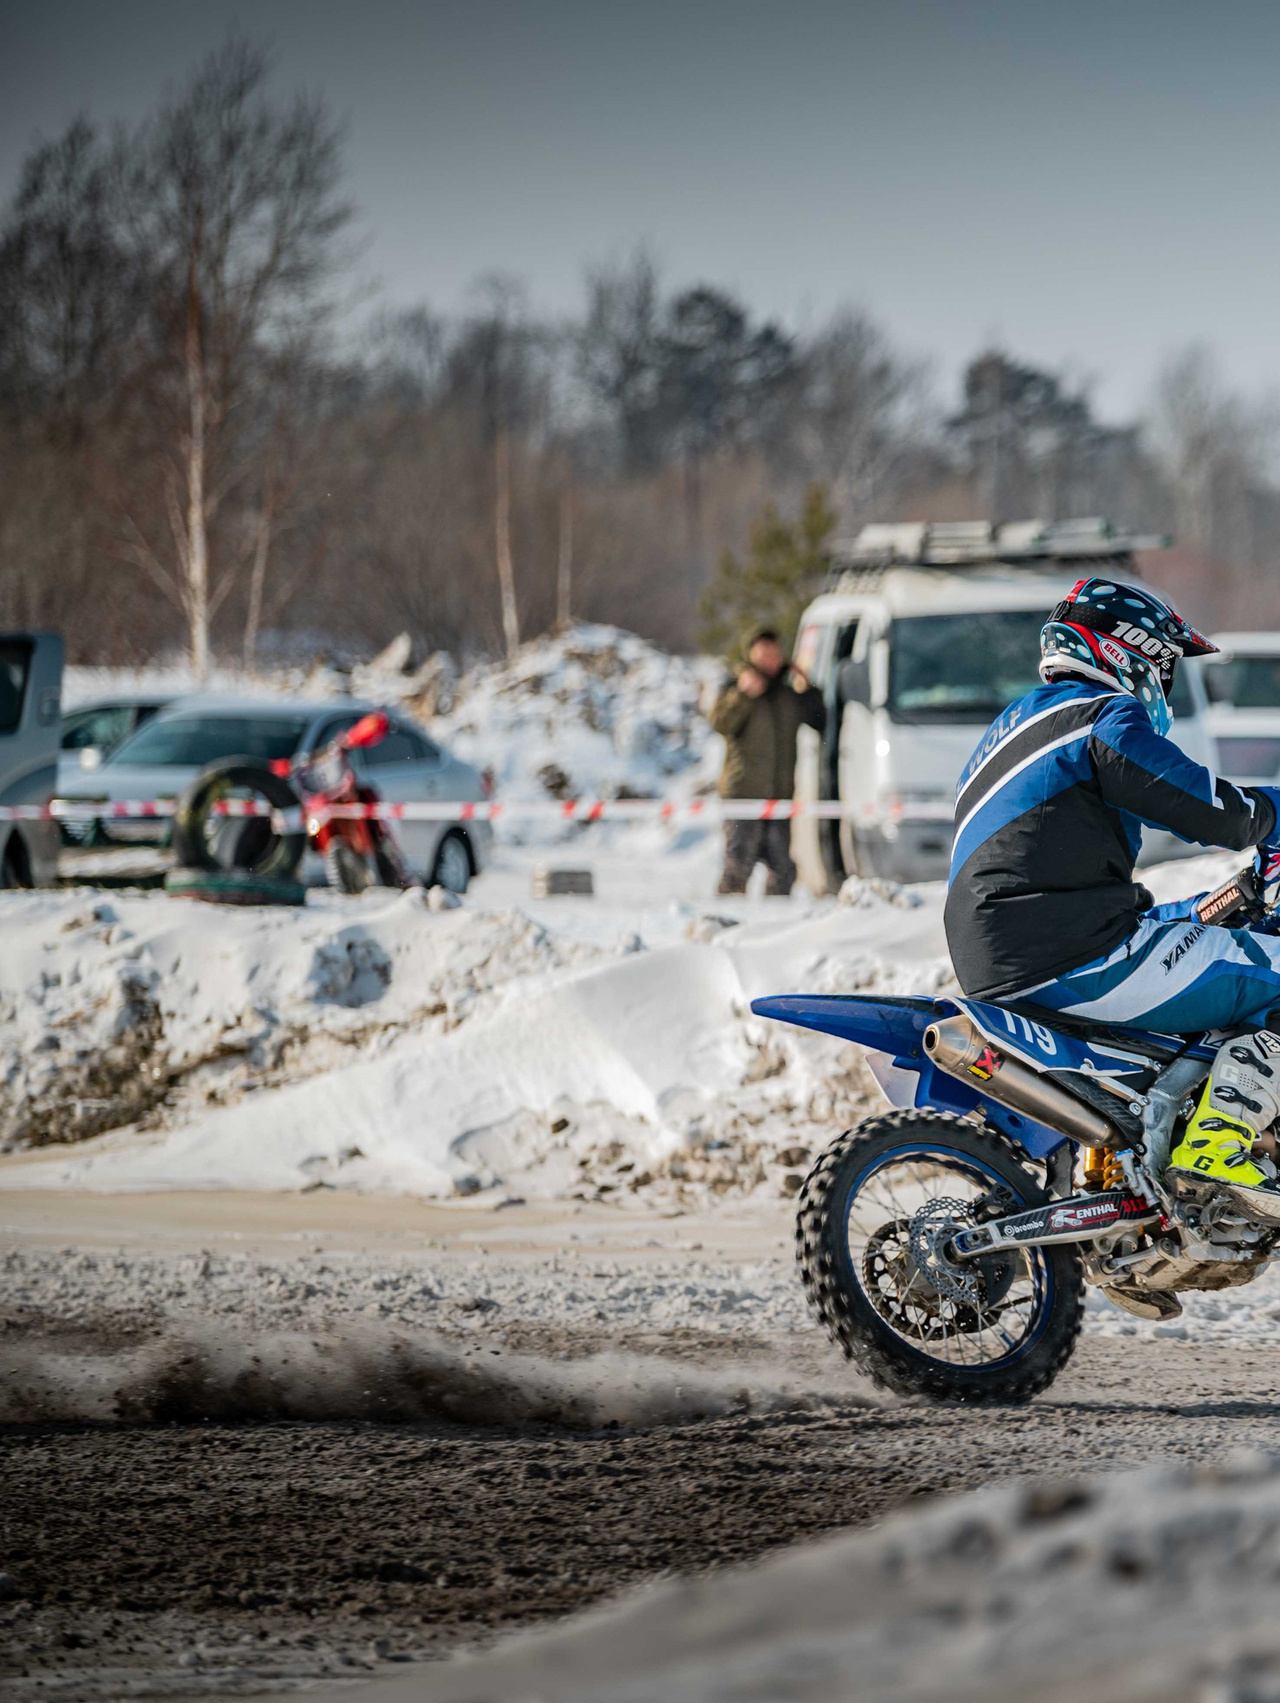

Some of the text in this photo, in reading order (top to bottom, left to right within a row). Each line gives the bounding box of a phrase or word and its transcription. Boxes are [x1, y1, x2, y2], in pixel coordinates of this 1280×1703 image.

[1103, 643, 1126, 665] BELL
[1110, 620, 1175, 671] 100%
[969, 706, 1022, 776] WOLF
[1200, 887, 1240, 923] RENTHAL
[1159, 923, 1209, 975] YAMA
[1050, 1203, 1118, 1229] RENTHAL
